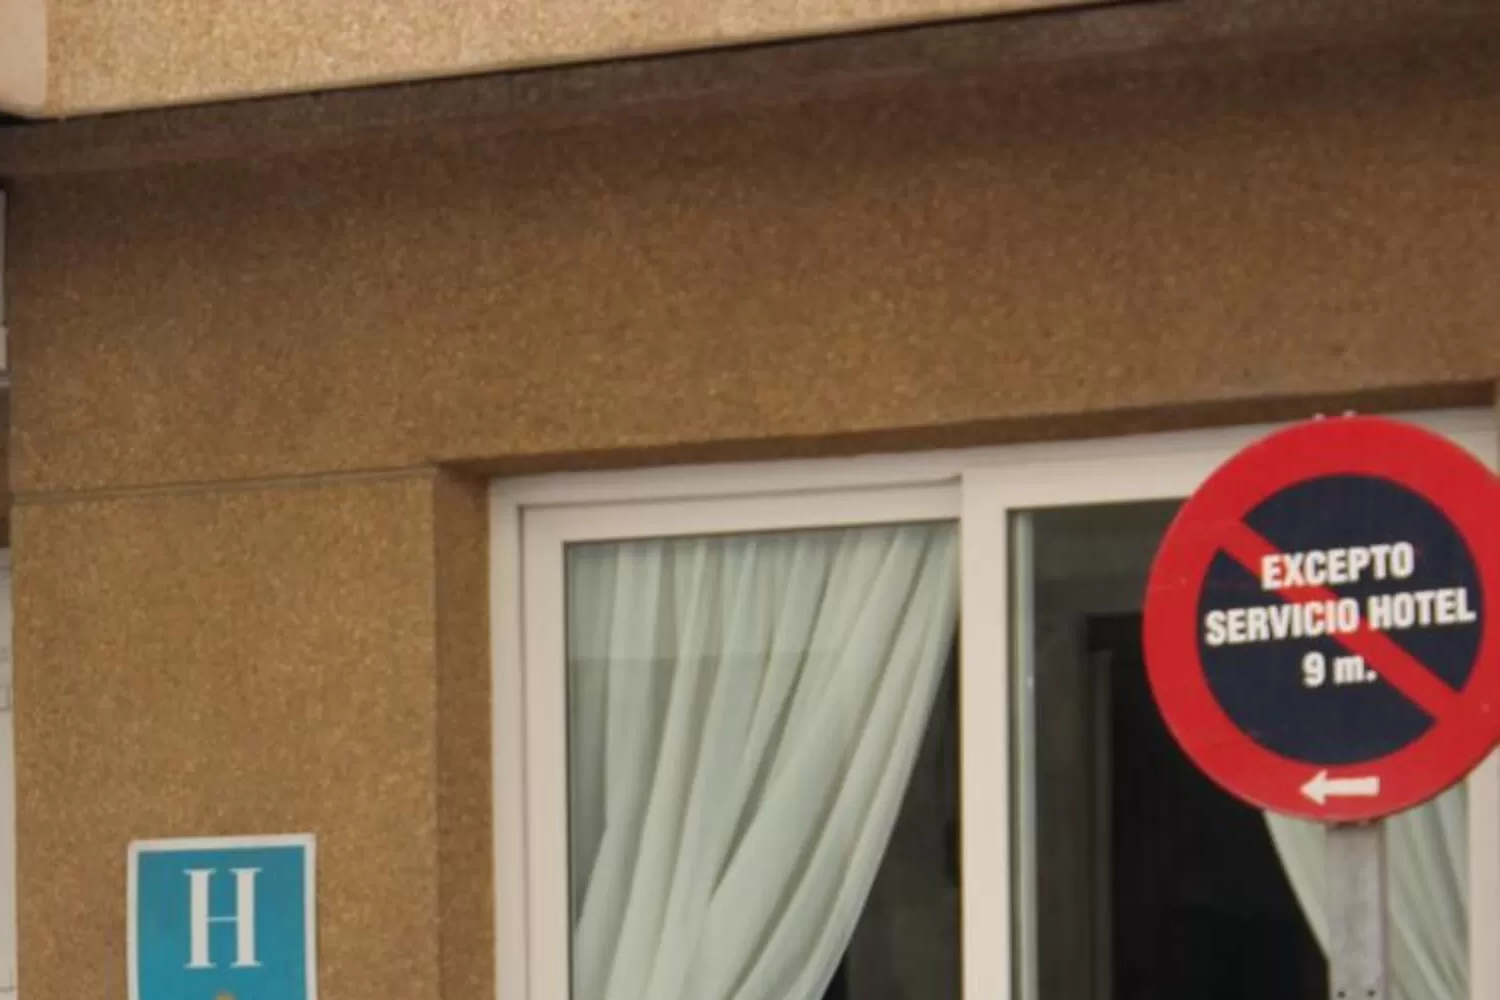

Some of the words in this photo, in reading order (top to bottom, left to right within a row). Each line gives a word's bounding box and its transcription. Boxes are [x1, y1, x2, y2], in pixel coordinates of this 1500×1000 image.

[1261, 542, 1414, 590] EXCEPTO
[1205, 599, 1360, 645] SERVICIO
[1368, 588, 1476, 629] HOTEL
[1303, 652, 1325, 687] 9
[1334, 655, 1377, 684] m.
[183, 867, 262, 968] H
